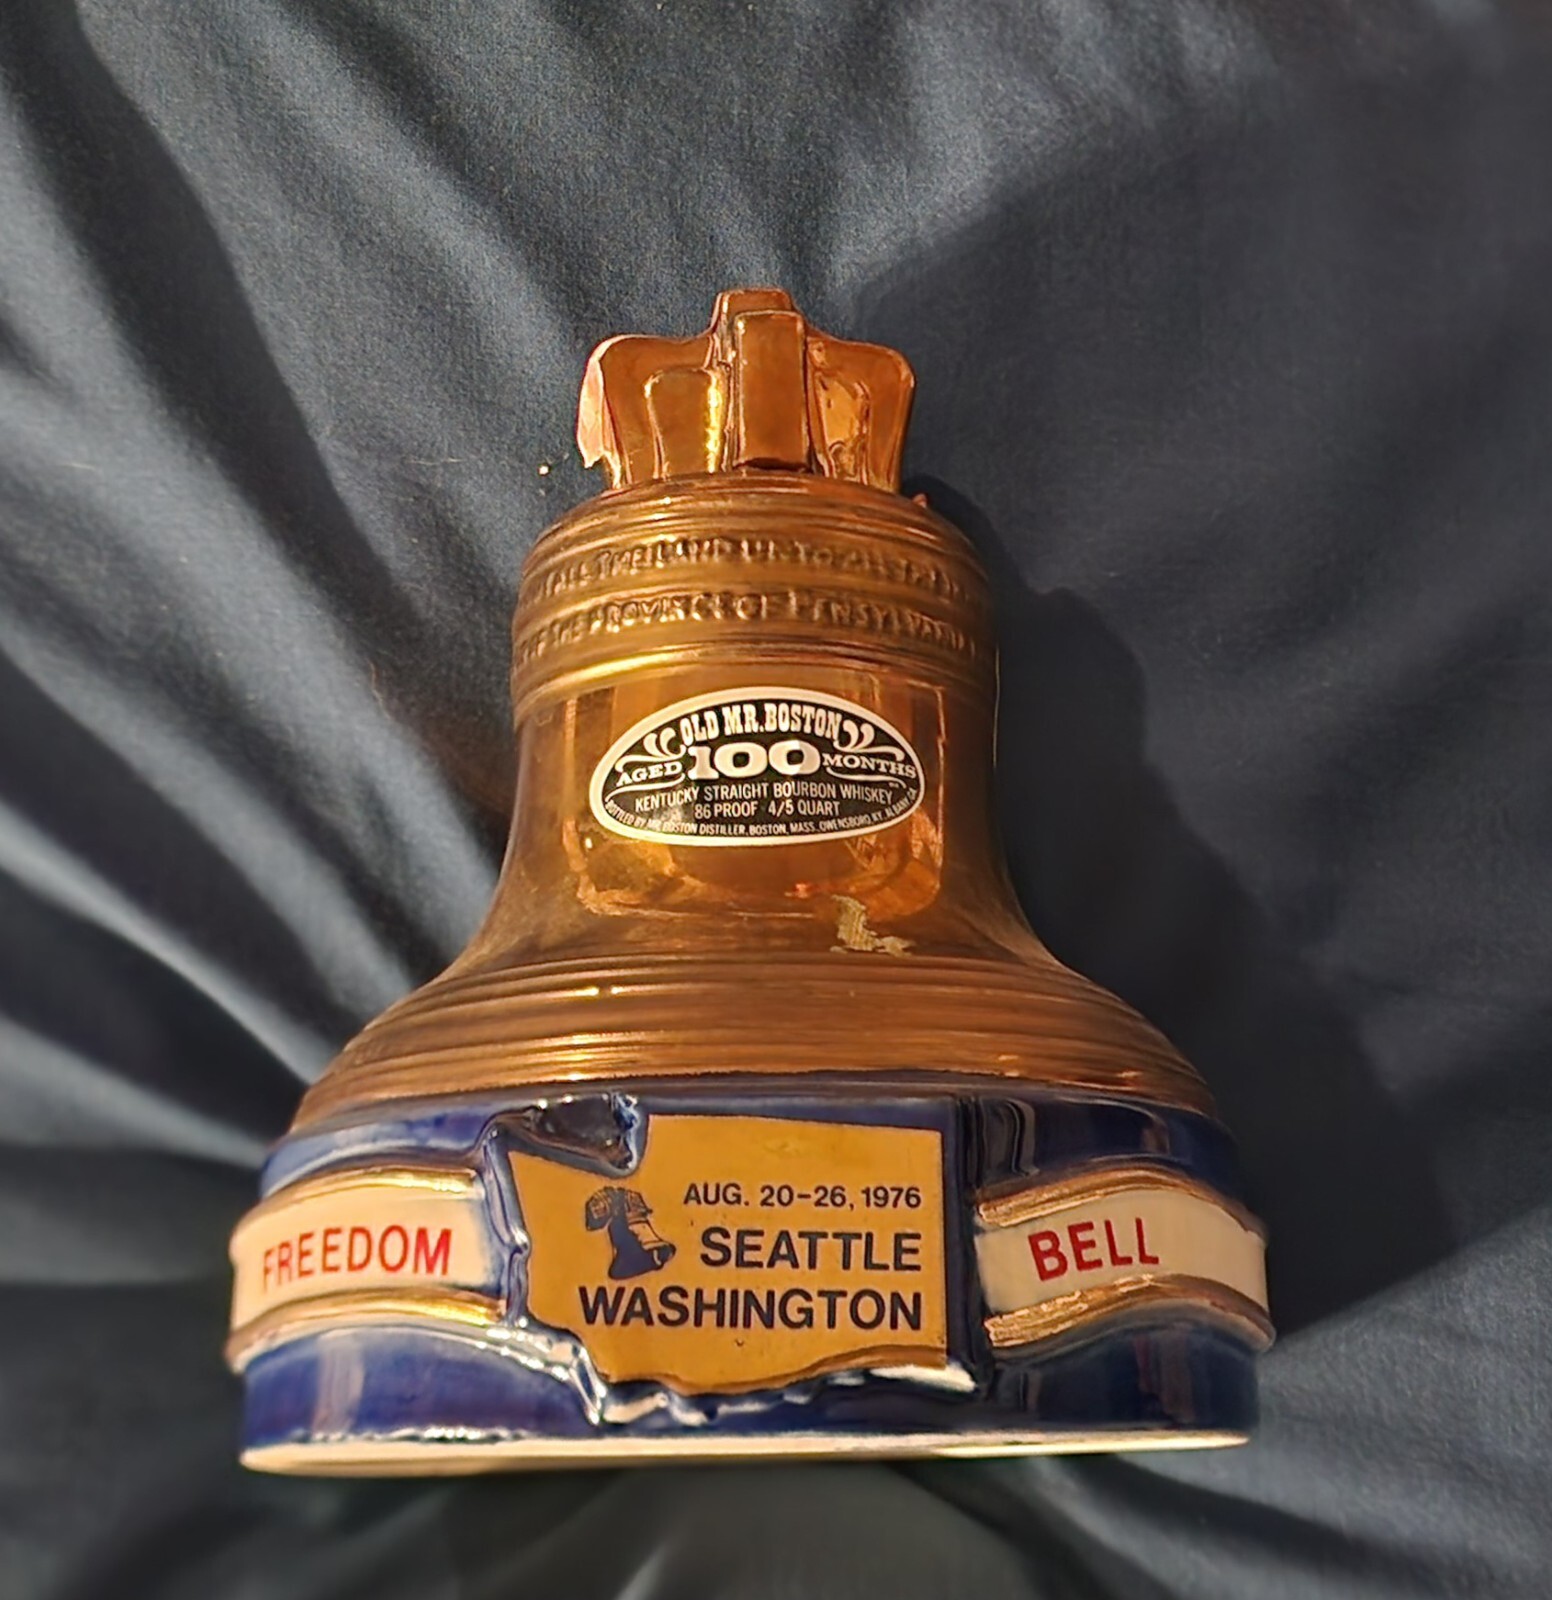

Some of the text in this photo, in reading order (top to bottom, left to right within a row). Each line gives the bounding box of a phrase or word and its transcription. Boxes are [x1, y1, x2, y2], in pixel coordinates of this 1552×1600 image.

[679, 710, 720, 746] OLD
[616, 740, 917, 787] AGED 100 MONTHS
[635, 781, 893, 813] KENTUCKY STRAIGHT BOURBON WHISKEY
[694, 798, 841, 819] 86 PROOF 4/5 QUART
[683, 1182, 750, 1207] AUG.
[860, 1186, 922, 1209] 1976
[261, 1224, 453, 1293] FREEDOM
[700, 1226, 922, 1272] SEATTLE
[1027, 1217, 1160, 1282] BELL
[578, 1284, 922, 1331] WASHINGTON
